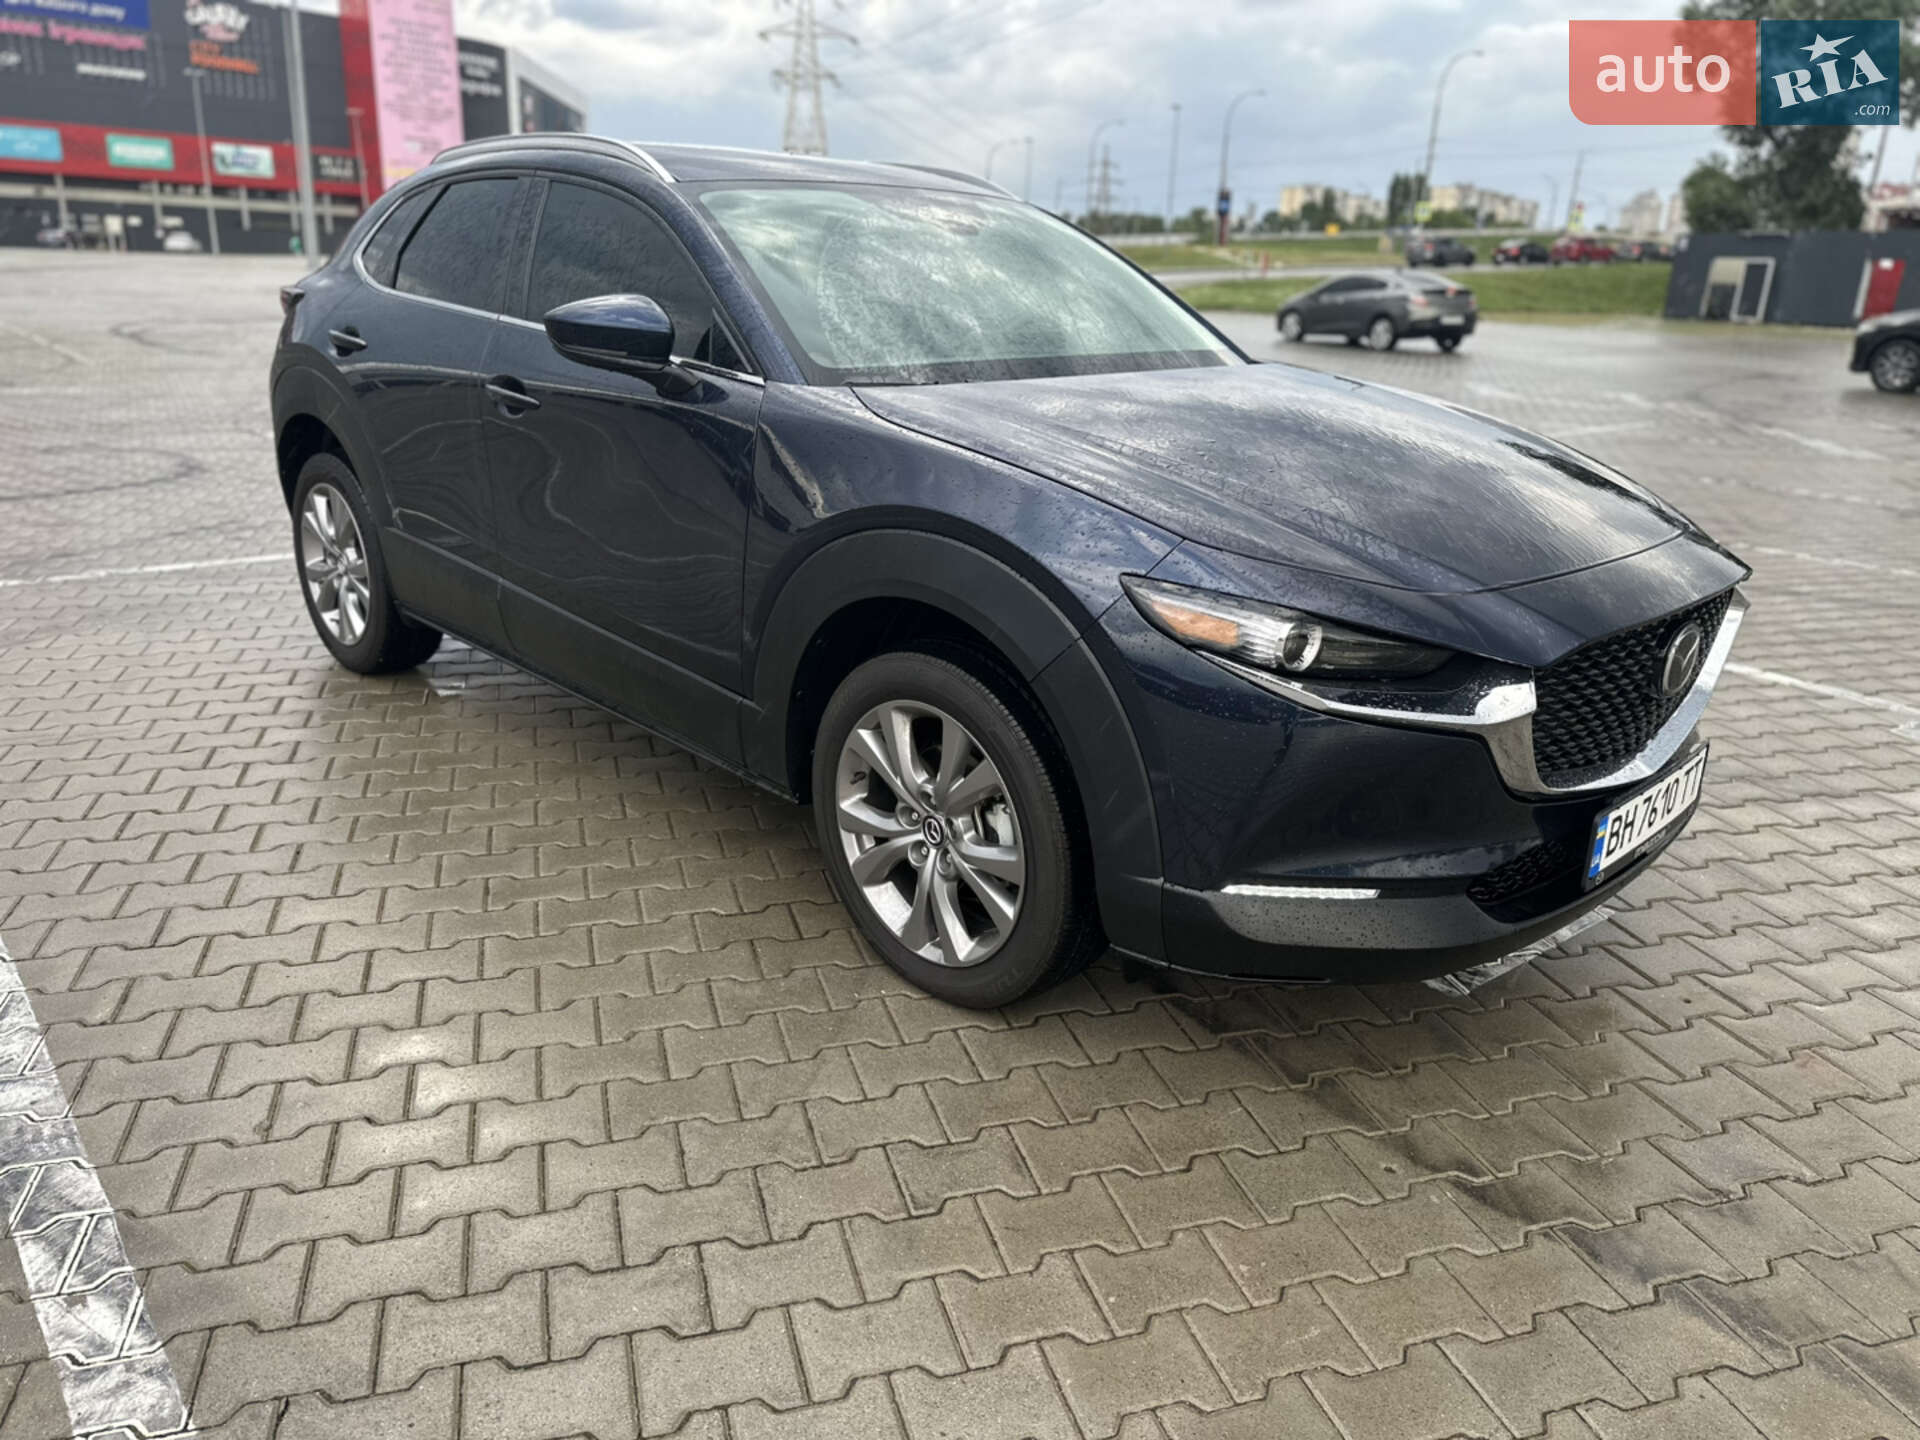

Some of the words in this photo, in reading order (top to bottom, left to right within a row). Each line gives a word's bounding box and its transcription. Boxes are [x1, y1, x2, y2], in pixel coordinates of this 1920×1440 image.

[1605, 804, 1639, 858] BH
[1637, 777, 1680, 838] 7610
[1681, 756, 1704, 805] TT
